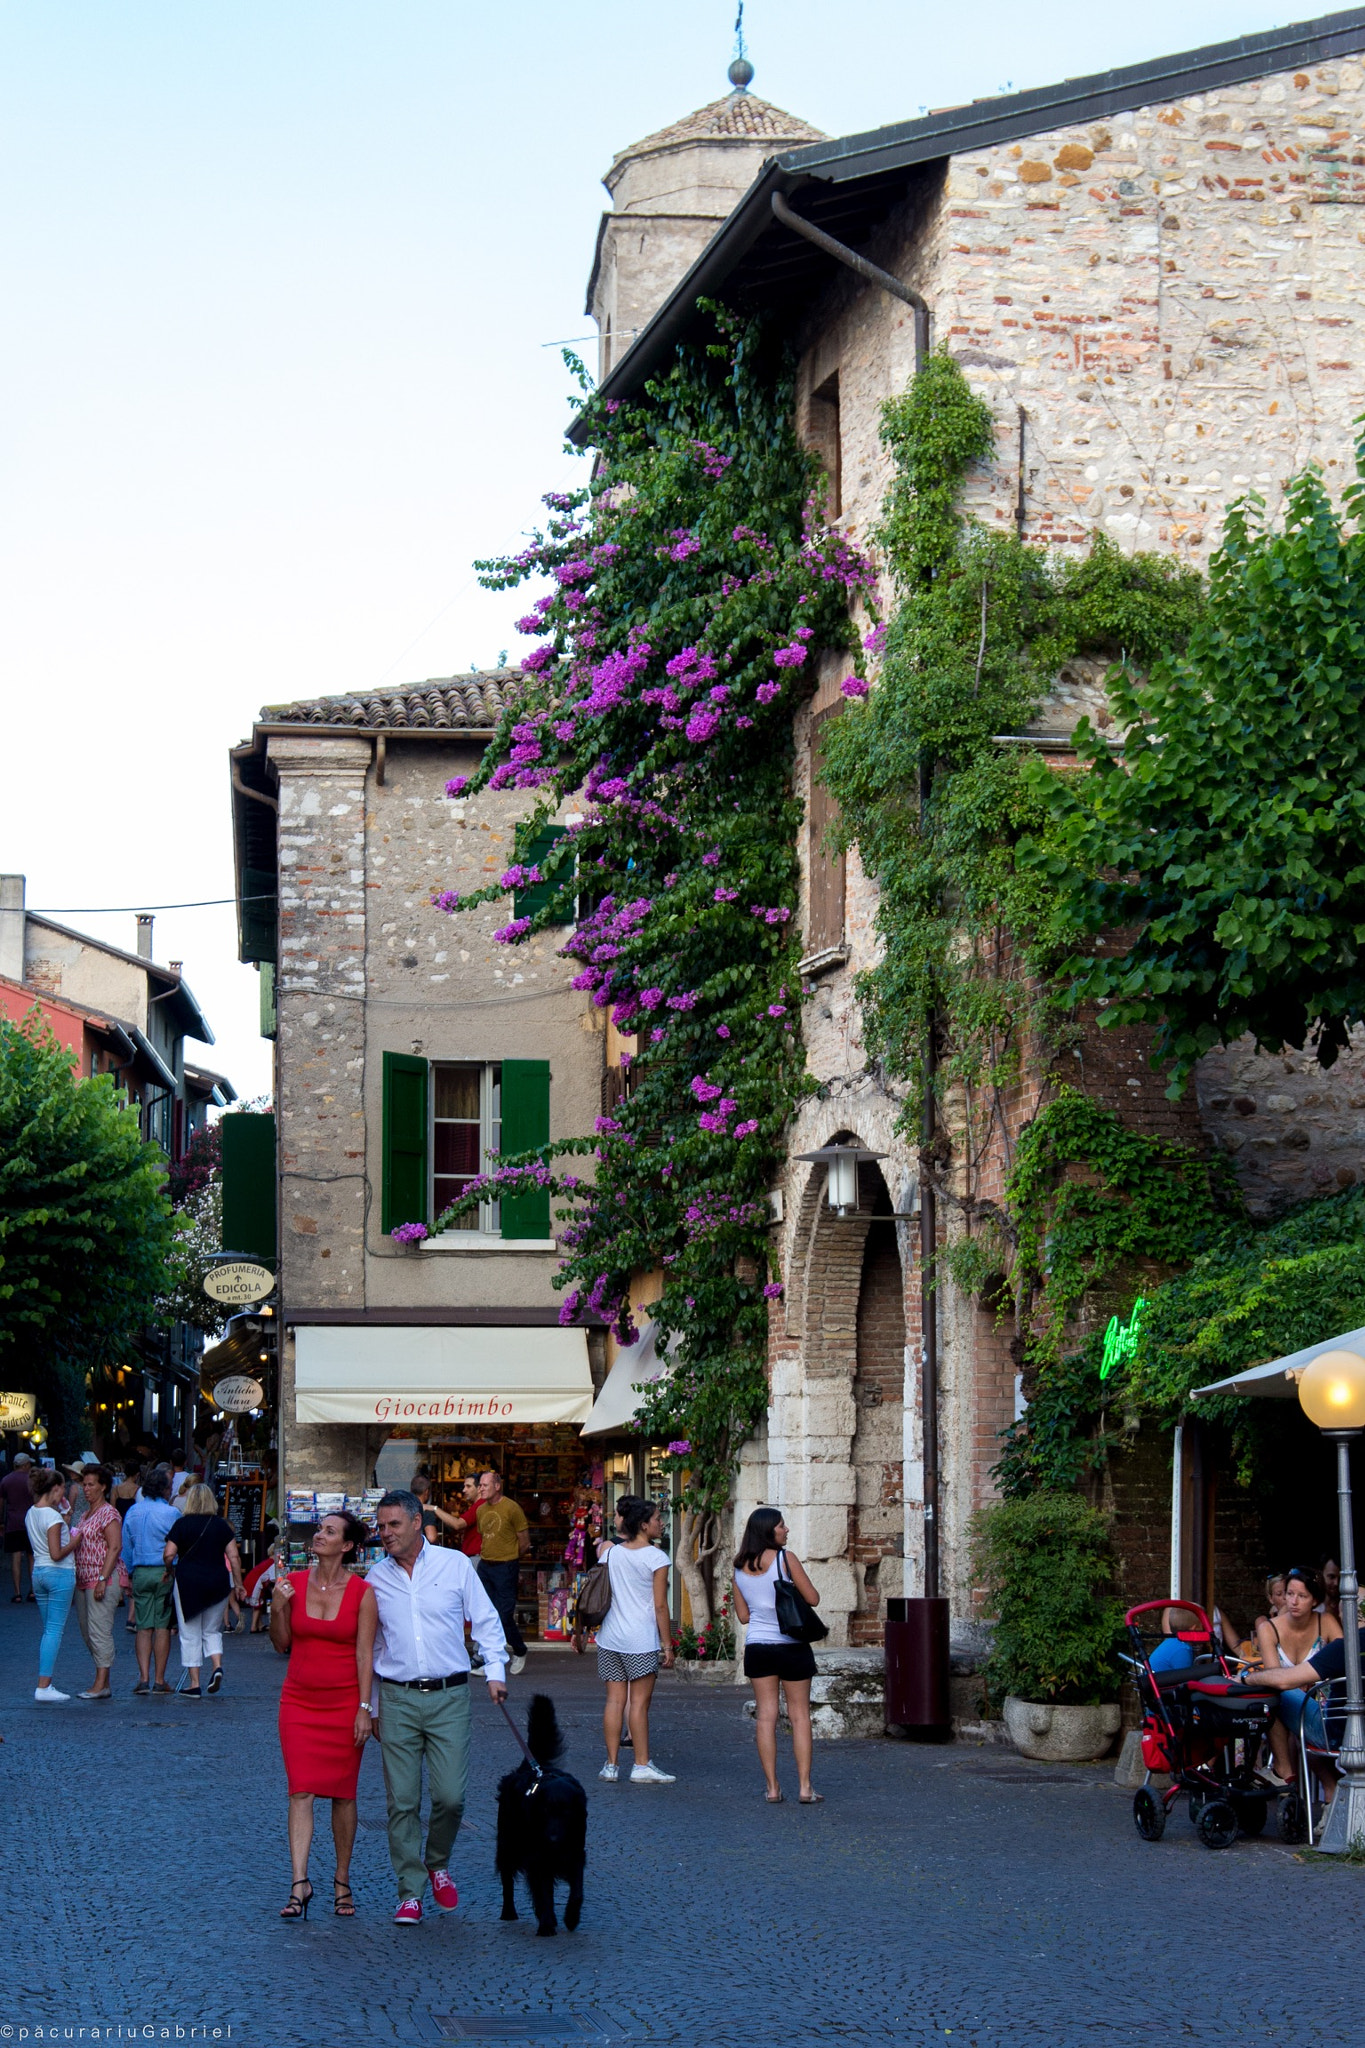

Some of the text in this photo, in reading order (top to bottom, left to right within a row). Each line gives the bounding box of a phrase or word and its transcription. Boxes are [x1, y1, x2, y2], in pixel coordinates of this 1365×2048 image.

[209, 1265, 266, 1281] PROFUMERIA
[216, 1283, 261, 1294] EDICOLA
[217, 1384, 257, 1394] Antiche
[223, 1395, 250, 1405] Mura
[375, 1396, 513, 1421] Giocabimbo
